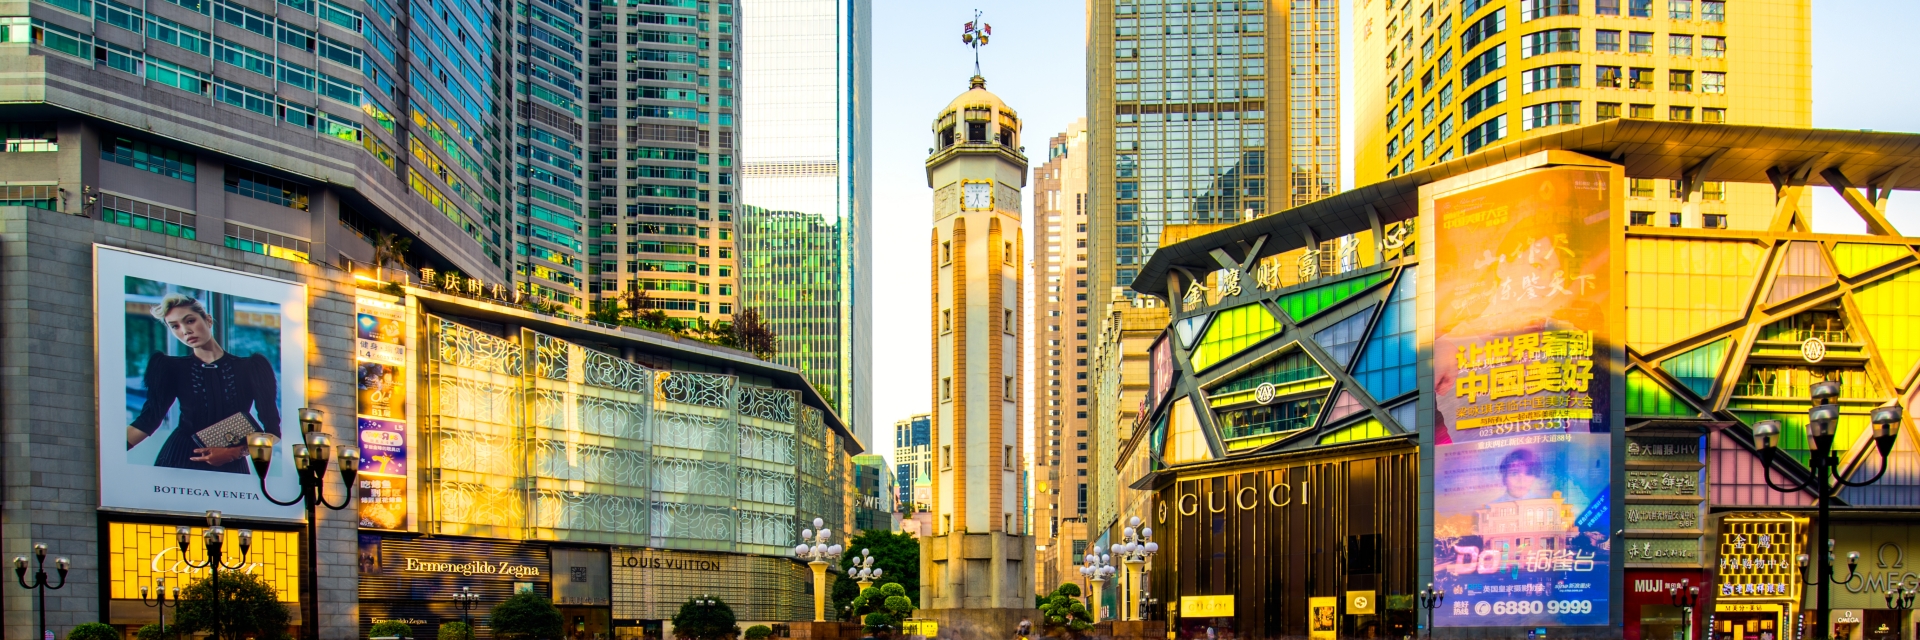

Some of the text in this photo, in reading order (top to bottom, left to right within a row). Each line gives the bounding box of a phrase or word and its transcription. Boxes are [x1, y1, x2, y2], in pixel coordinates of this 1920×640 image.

[1183, 227, 1407, 305] 金鹰财富中心
[1479, 416, 1571, 438] 023 8918 3333
[153, 485, 260, 500] BOTTEGA VENETA
[1178, 481, 1308, 516] GUCCI
[405, 557, 540, 578] Ermenegildo Zegna
[621, 556, 720, 571] LOUIS VUITTON
[1634, 579, 1663, 593] MUJI
[1493, 600, 1592, 615] 6880 9999
[1837, 616, 1860, 624] OMEGA
